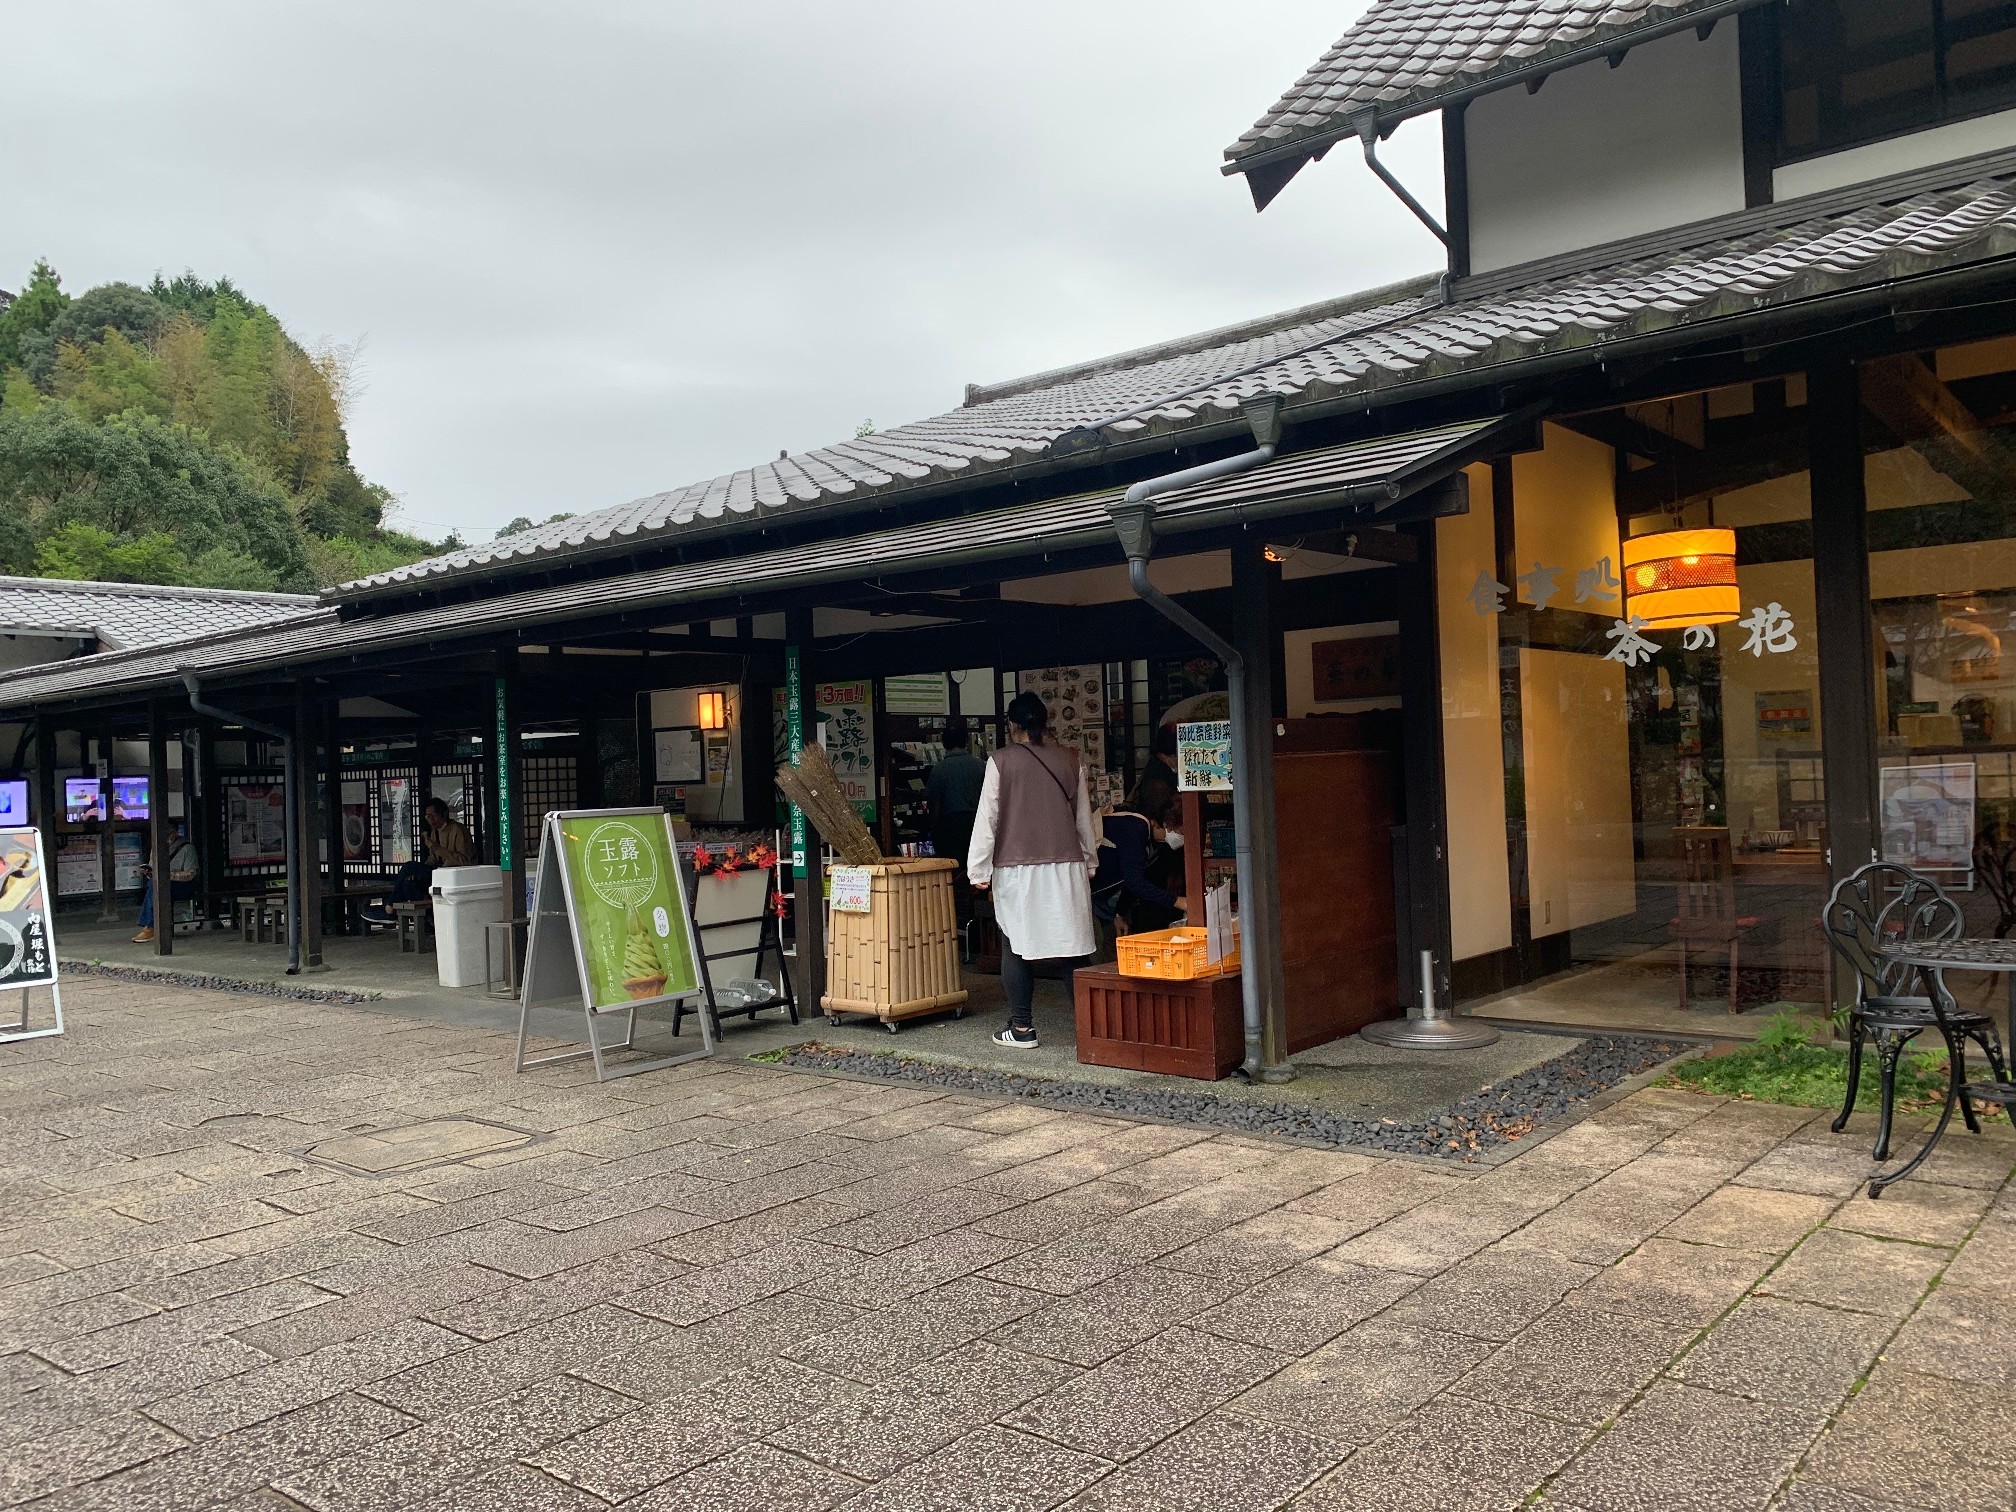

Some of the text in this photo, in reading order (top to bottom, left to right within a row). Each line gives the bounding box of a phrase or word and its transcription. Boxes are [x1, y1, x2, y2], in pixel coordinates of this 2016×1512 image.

[1466, 557, 1620, 618] 食事処
[1601, 601, 1798, 667] 茶の花
[497, 687, 509, 861] お気軽にお茶室をお楽しみ下さい。
[788, 656, 804, 845] 日本玉露三大産地、奈玉露
[598, 837, 640, 862] 玉露
[604, 864, 642, 879] ソフト
